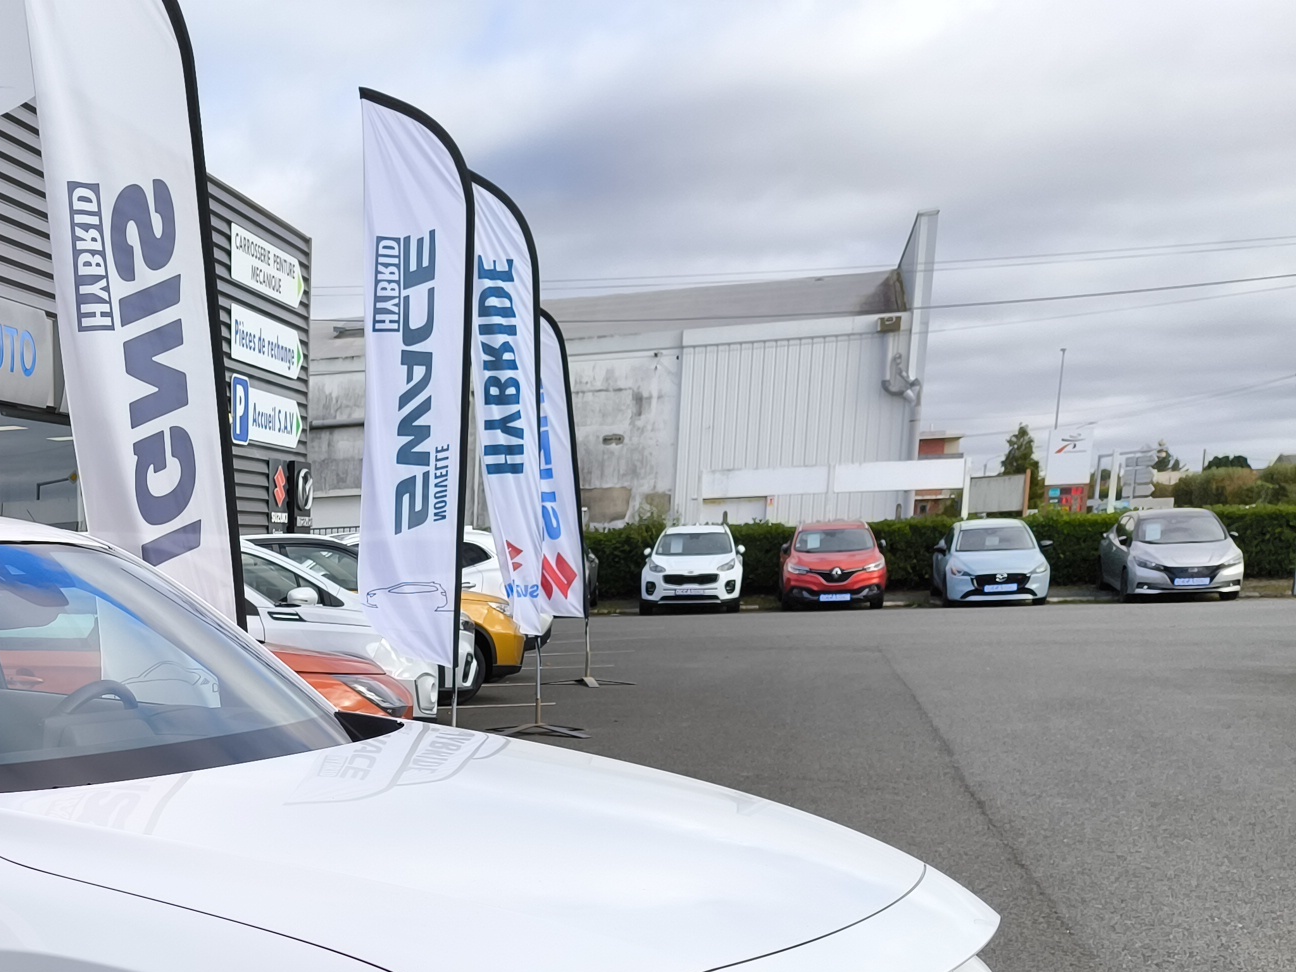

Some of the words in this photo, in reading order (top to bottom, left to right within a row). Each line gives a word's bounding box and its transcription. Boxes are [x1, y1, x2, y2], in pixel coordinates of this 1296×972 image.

[234, 232, 271, 267] CARROSSERIE
[272, 253, 296, 280] PEINTURE
[250, 264, 282, 294] MECANIQUE
[234, 319, 257, 352] Pièces
[257, 328, 266, 355] de
[267, 335, 295, 371] rechange
[252, 402, 276, 432] Accueil
